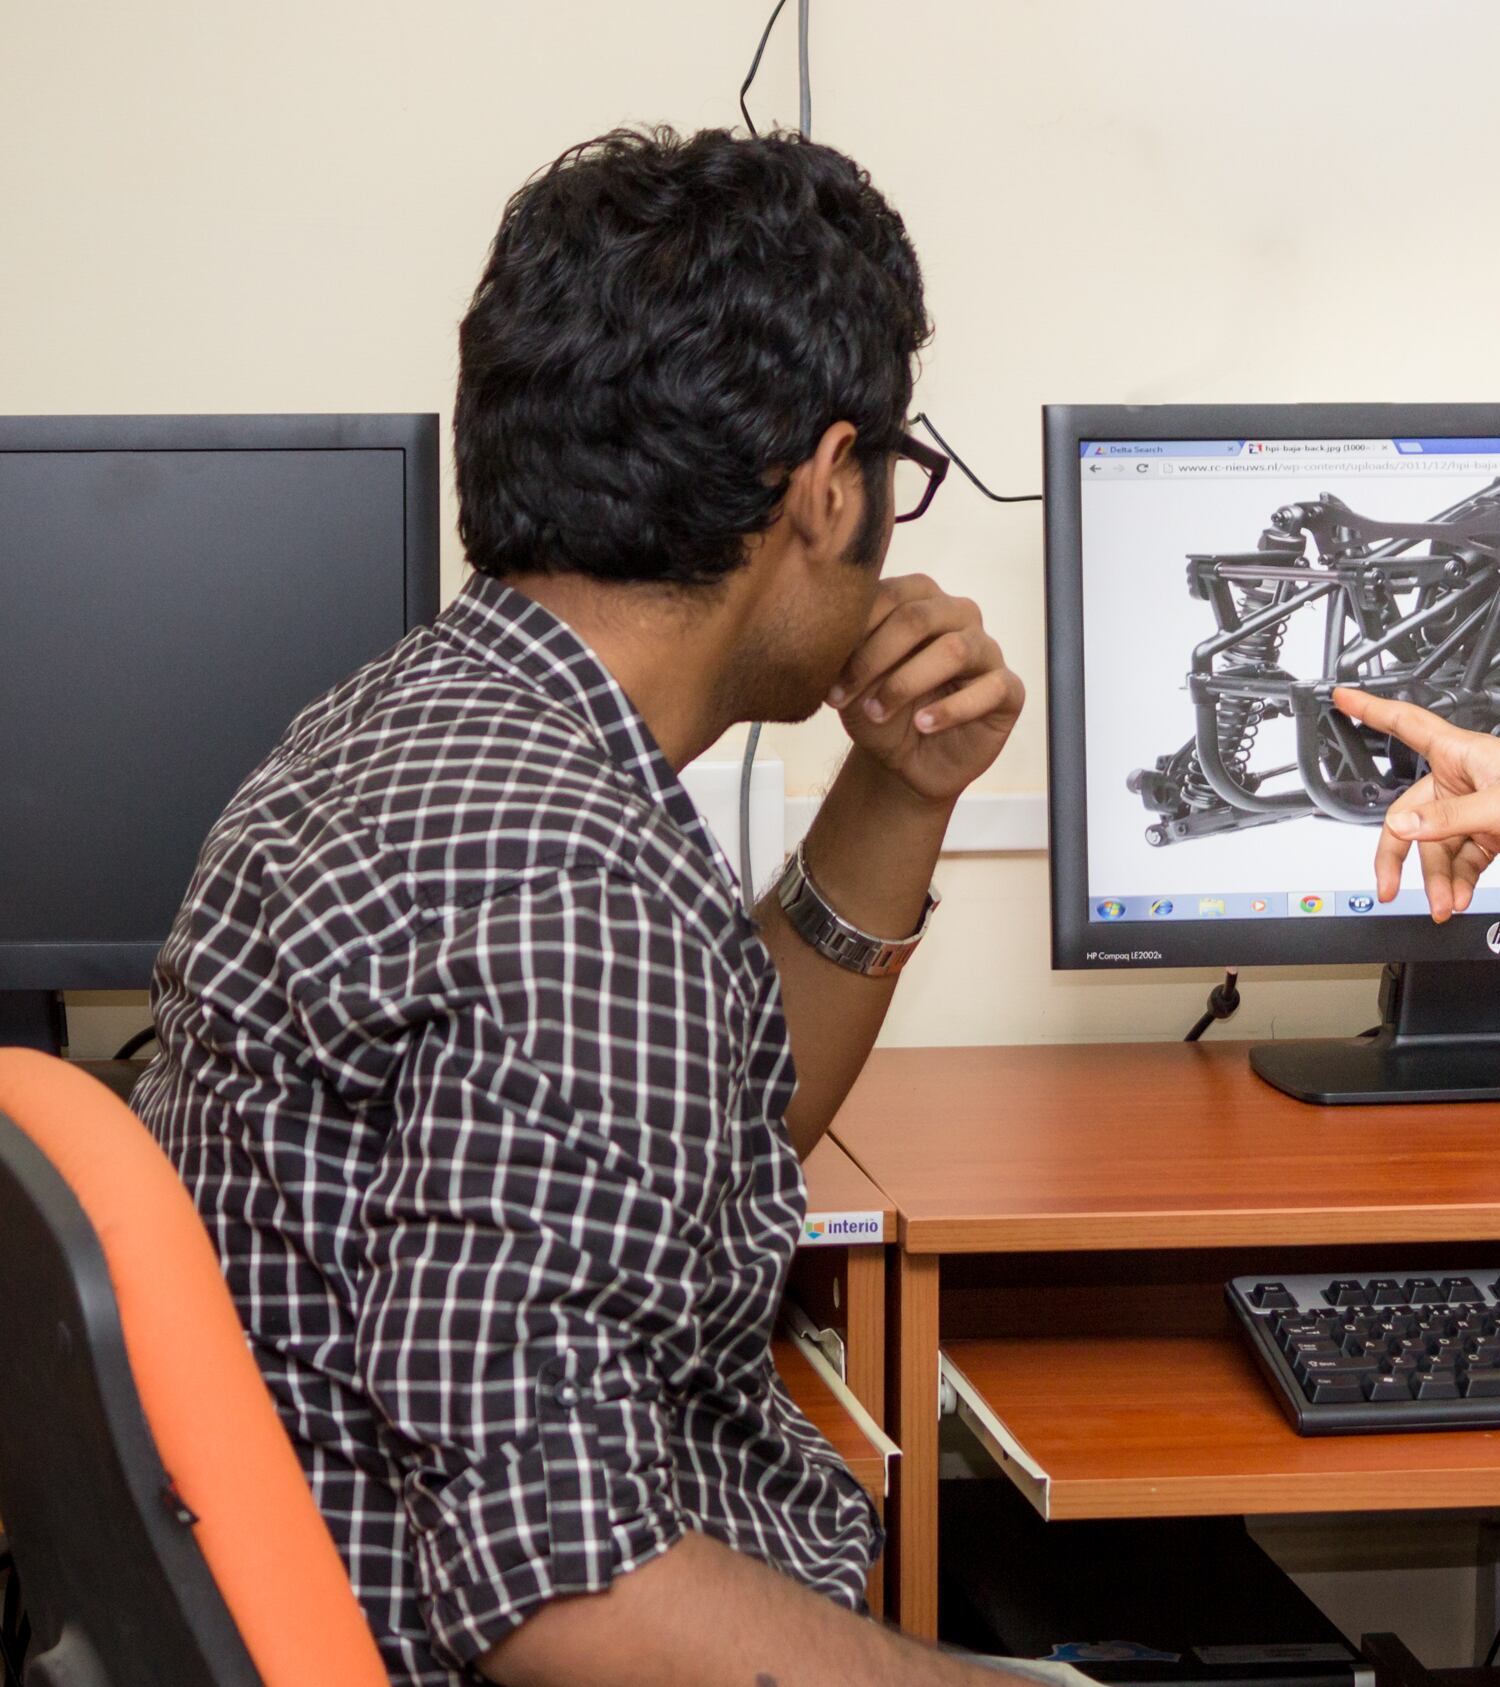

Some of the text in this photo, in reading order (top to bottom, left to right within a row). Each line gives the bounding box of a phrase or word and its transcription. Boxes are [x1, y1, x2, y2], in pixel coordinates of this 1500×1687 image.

[1109, 445, 1163, 454] Delta Search
[1086, 950, 1162, 962] HP Compaq LE2002x
[827, 1219, 878, 1234] interio
